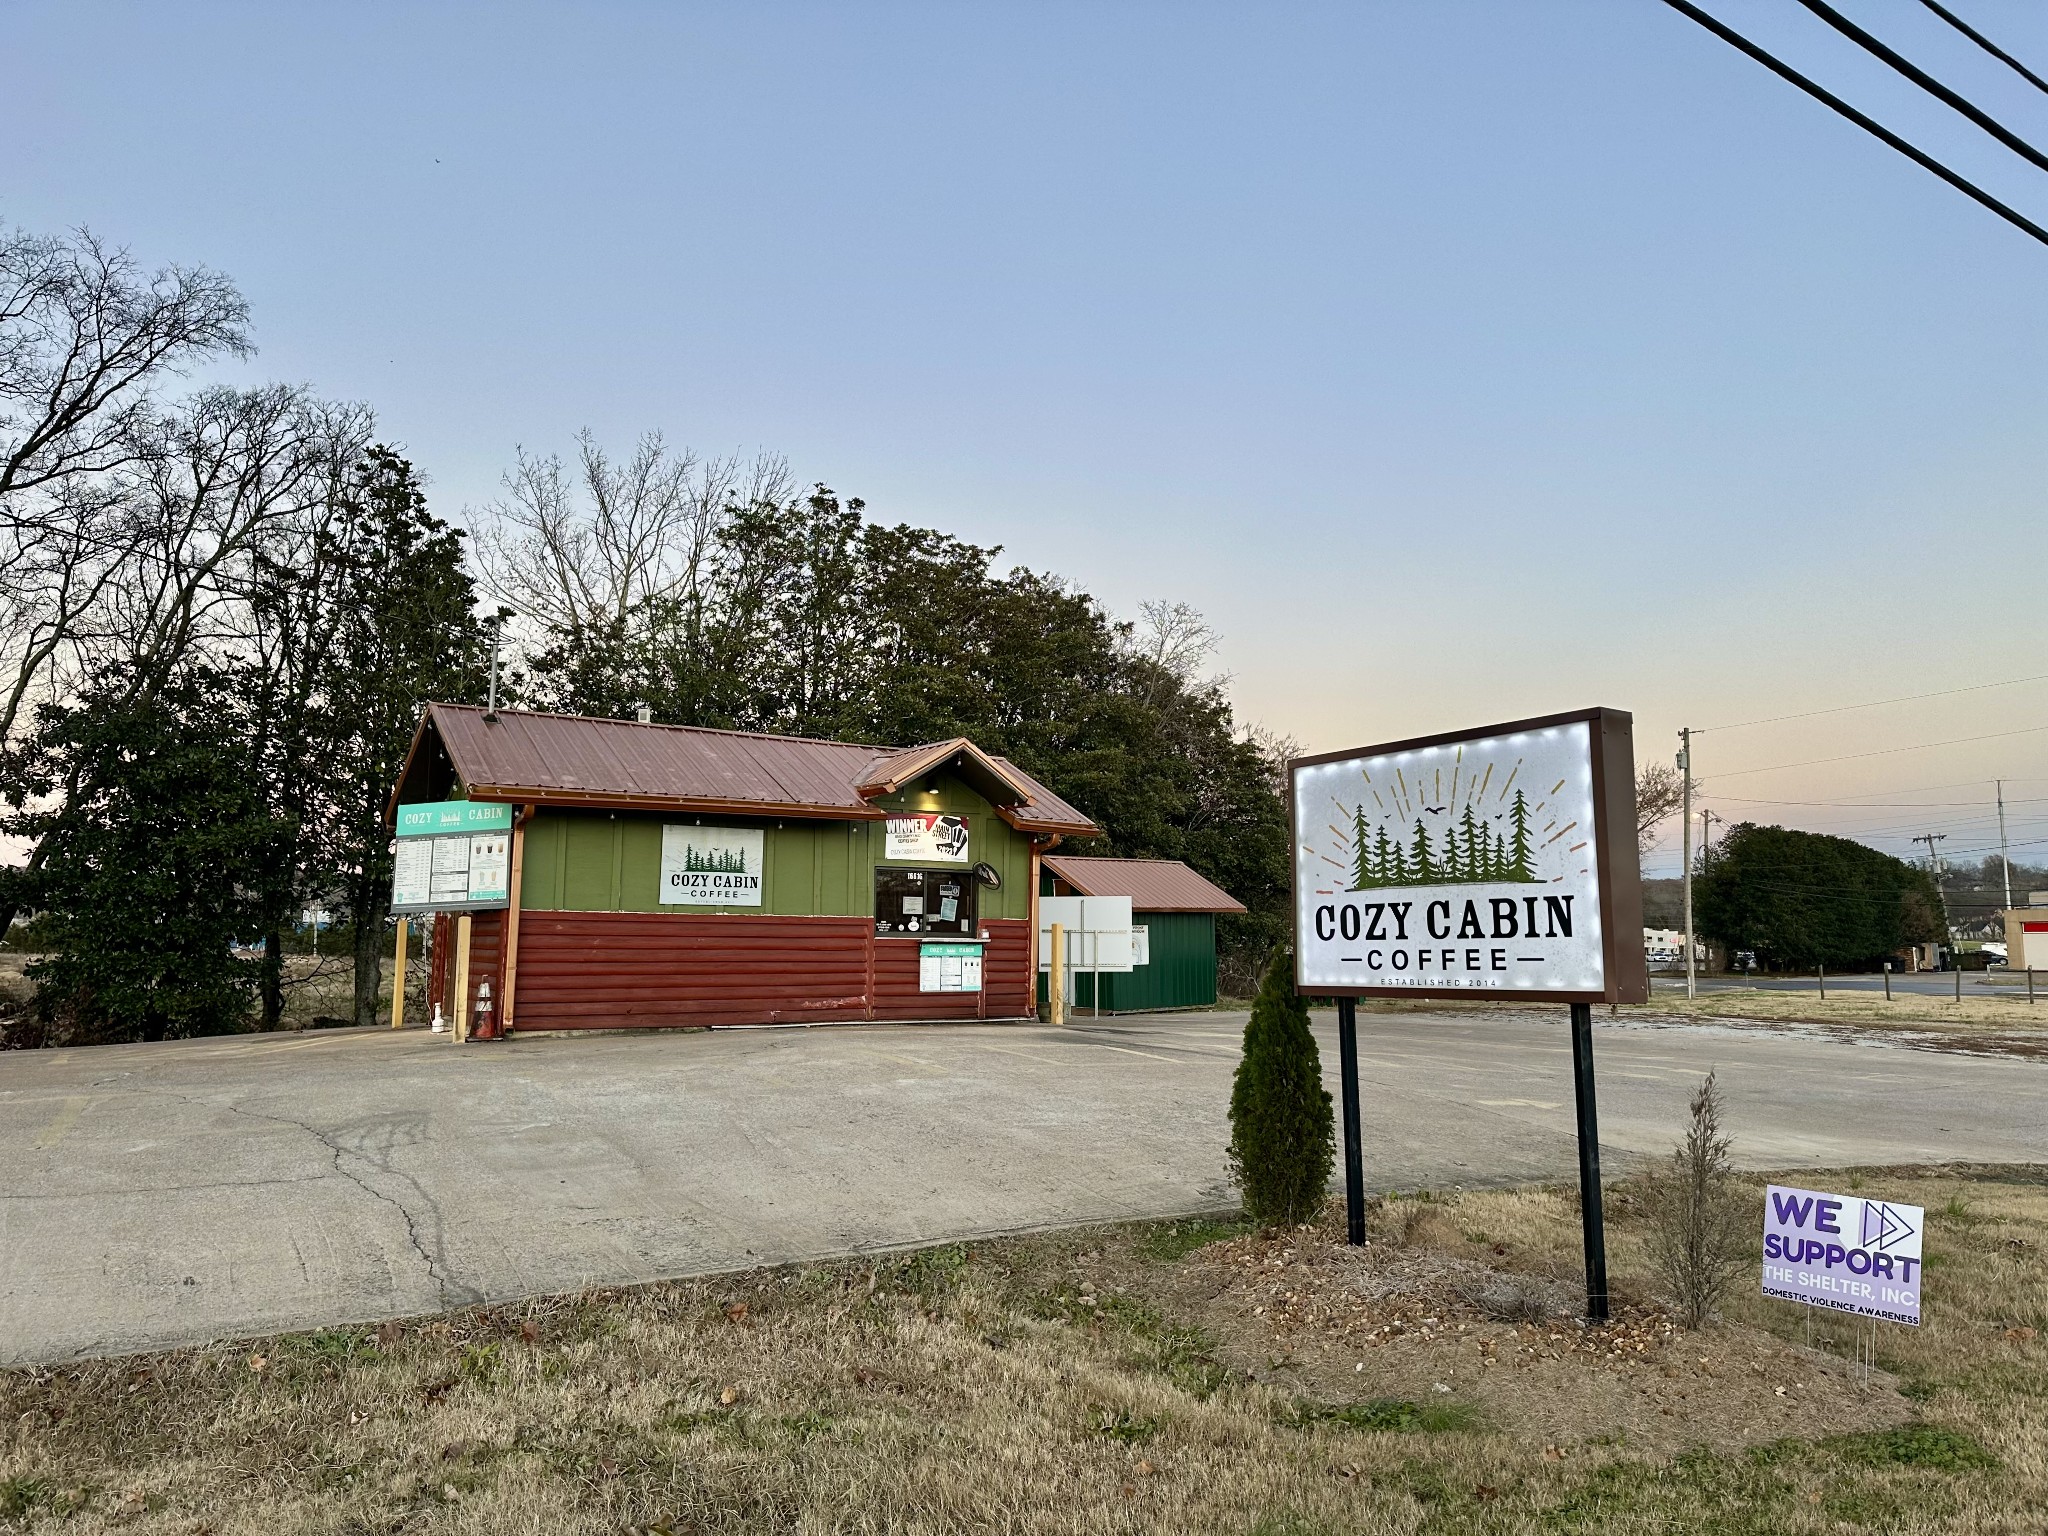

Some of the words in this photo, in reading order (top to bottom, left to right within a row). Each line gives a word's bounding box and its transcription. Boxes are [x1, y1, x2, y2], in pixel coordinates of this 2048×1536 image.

[405, 812, 432, 825] COZY
[468, 807, 503, 820] CABIN
[885, 819, 927, 834] WINNER
[671, 874, 709, 887] COZY
[714, 875, 758, 889] CABIN
[690, 889, 739, 898] COFFEE
[1315, 902, 1413, 942] COZY
[1426, 894, 1575, 940] CABIN
[1367, 948, 1508, 971] COFFEE
[1380, 978, 1461, 987] ESTABLISHED
[1468, 978, 1497, 987] 2014
[1772, 1192, 1843, 1235] WE
[1764, 1233, 1920, 1283] SUPPORT
[1763, 1264, 1793, 1283] THE
[1798, 1271, 1876, 1301] SHELTER,
[1881, 1286, 1920, 1308] INC.
[1762, 1286, 1808, 1302] DOMESTIC
[1809, 1296, 1856, 1312] VIOLENCE
[1858, 1305, 1919, 1325] AWARENESS
